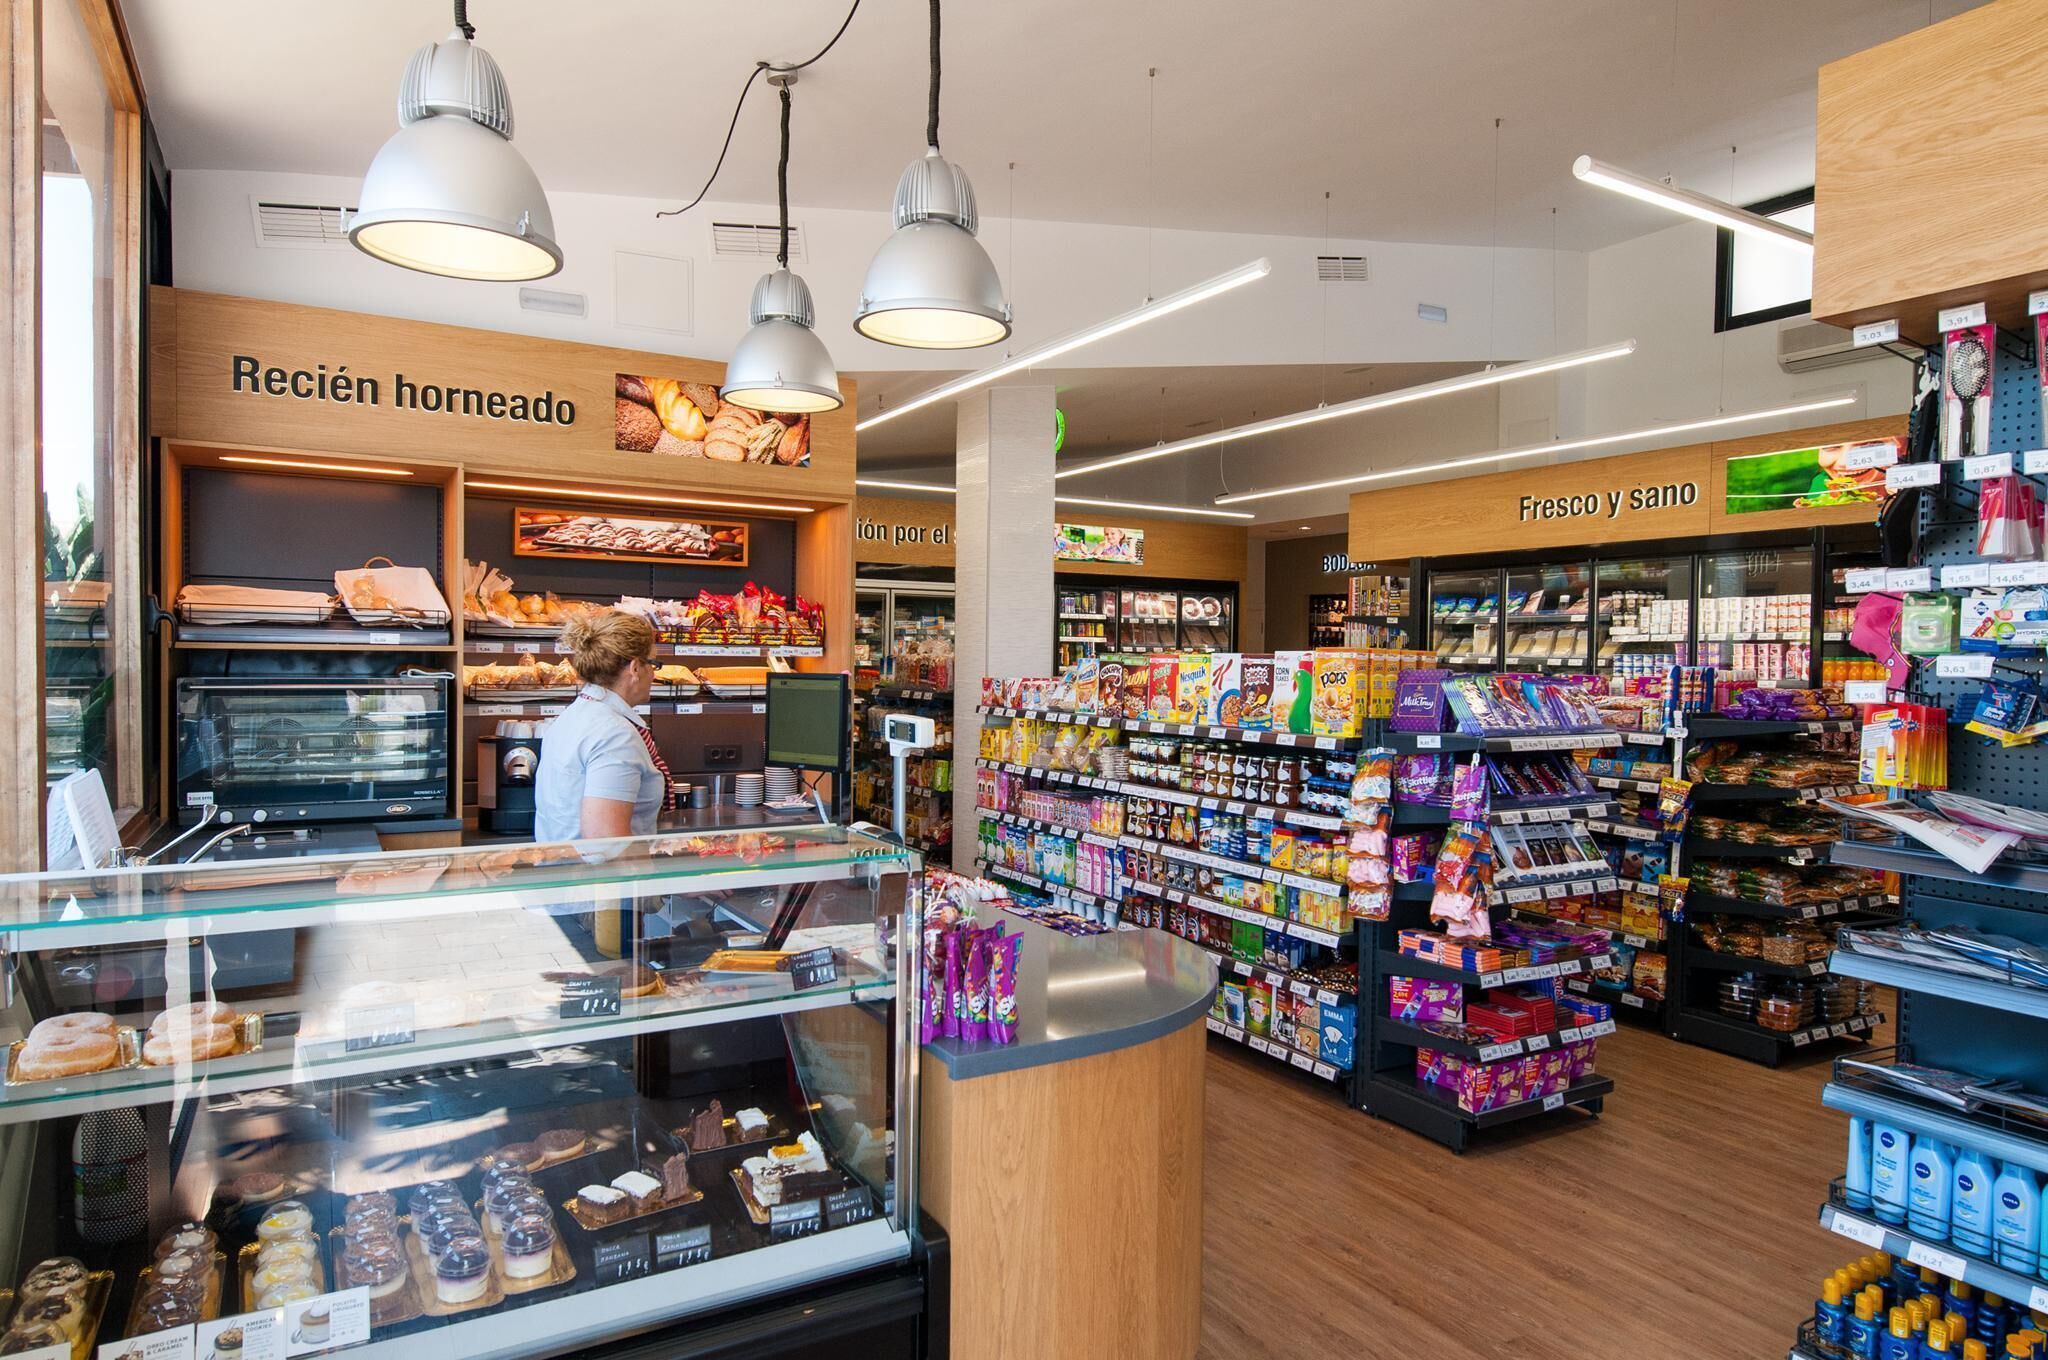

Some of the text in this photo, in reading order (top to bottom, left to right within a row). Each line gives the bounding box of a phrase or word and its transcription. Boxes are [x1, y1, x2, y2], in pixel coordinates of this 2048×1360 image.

[1948, 316, 1969, 326] 3,91
[1861, 331, 1882, 340] 3,03
[232, 354, 576, 428] Recién horneado
[1852, 456, 1872, 465] 2,63
[1974, 465, 1996, 474] 0,87
[1894, 475, 1914, 484] 3,44
[1519, 482, 1698, 522] Fresco y sano
[894, 526, 926, 546] por
[932, 524, 948, 544] el
[1894, 578, 1914, 587] 1,12
[1995, 574, 2025, 583] 14,65
[1851, 580, 1871, 589] 3,44
[1180, 666, 1206, 682] Nesquik
[1276, 667, 1290, 676] CORN
[1944, 666, 1966, 674] 3,63
[1856, 692, 1876, 700] 1,50
[1324, 1009, 1344, 1022] EMMA
[1305, 1036, 1312, 1048] 2
[246, 1324, 272, 1332] COOKIES
[146, 1336, 188, 1350] OREO CREAM
[152, 1344, 183, 1354] CARAMEL
